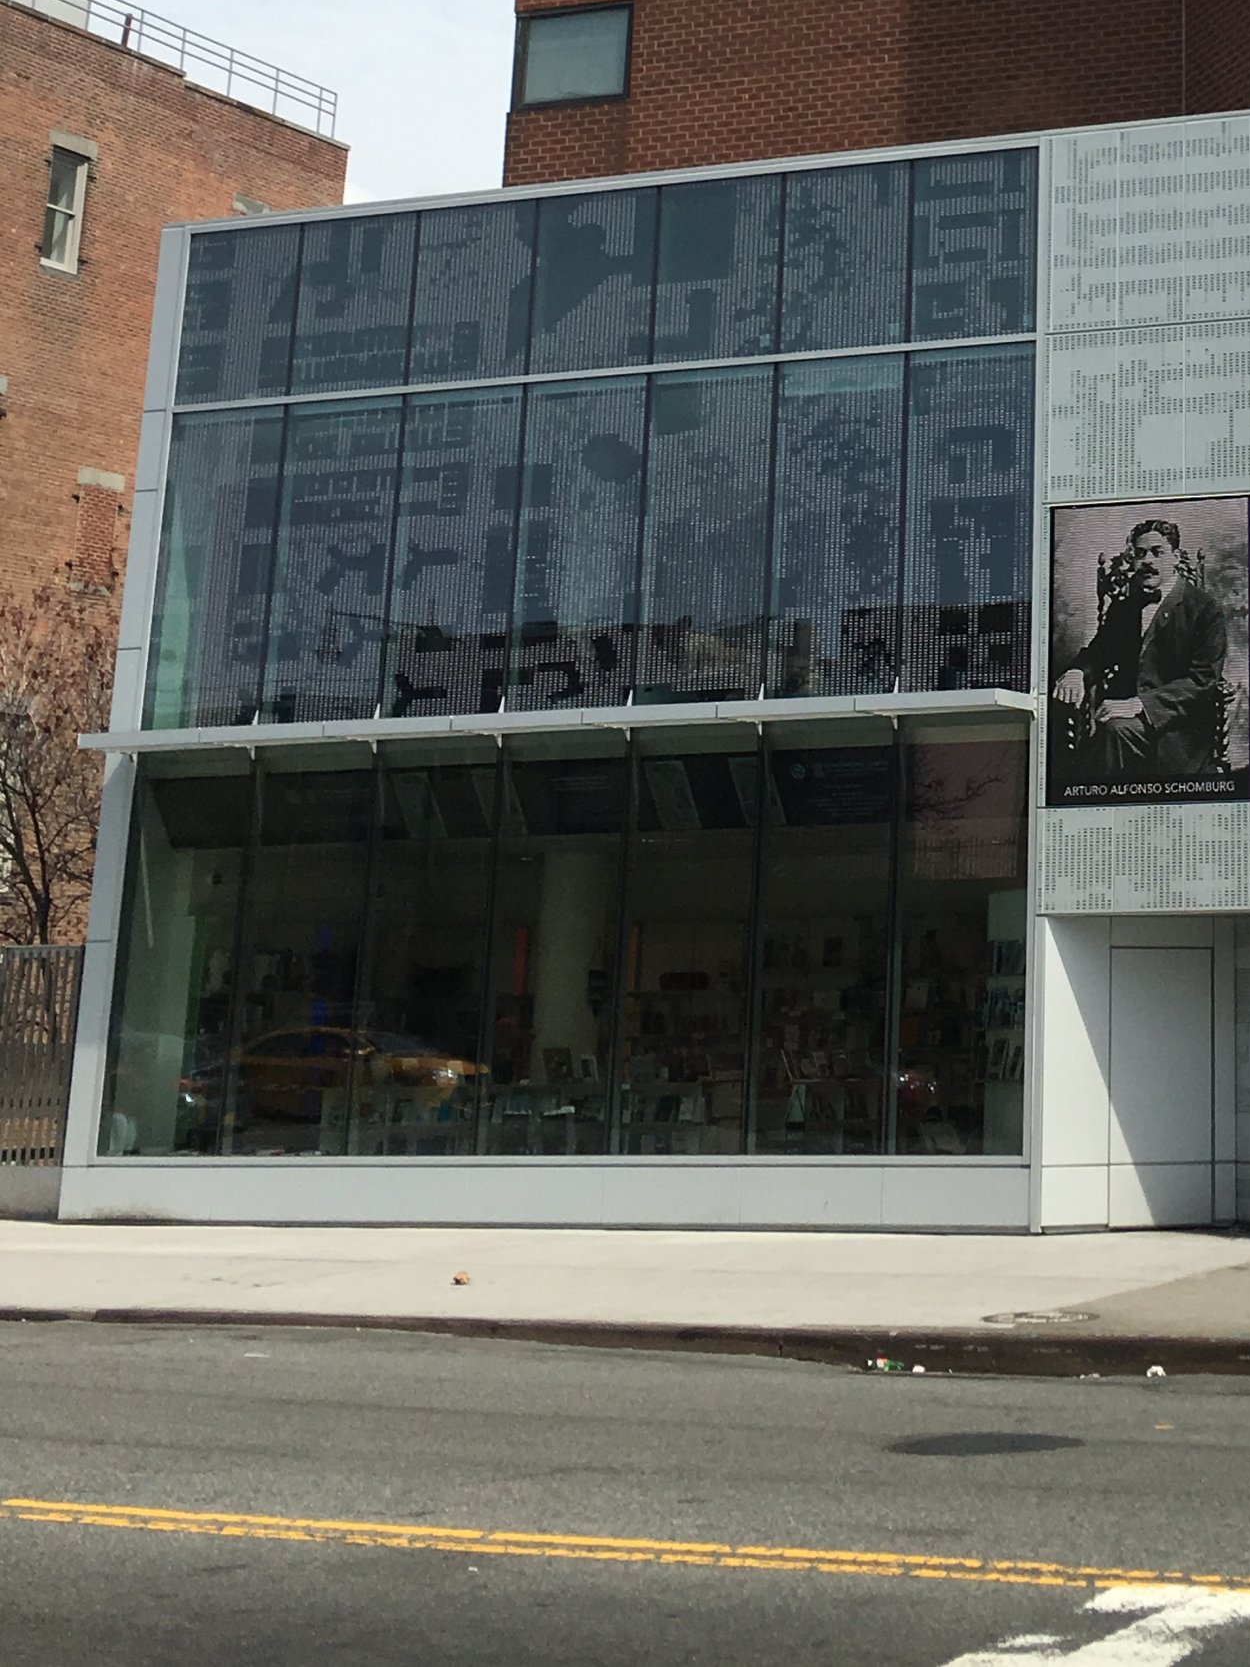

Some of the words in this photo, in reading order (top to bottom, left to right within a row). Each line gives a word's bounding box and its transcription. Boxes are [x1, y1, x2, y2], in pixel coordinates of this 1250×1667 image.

[1064, 784, 1108, 796] ARTURO
[1110, 782, 1162, 795] ALFONSO
[1165, 780, 1235, 794] SCHOMBURG
